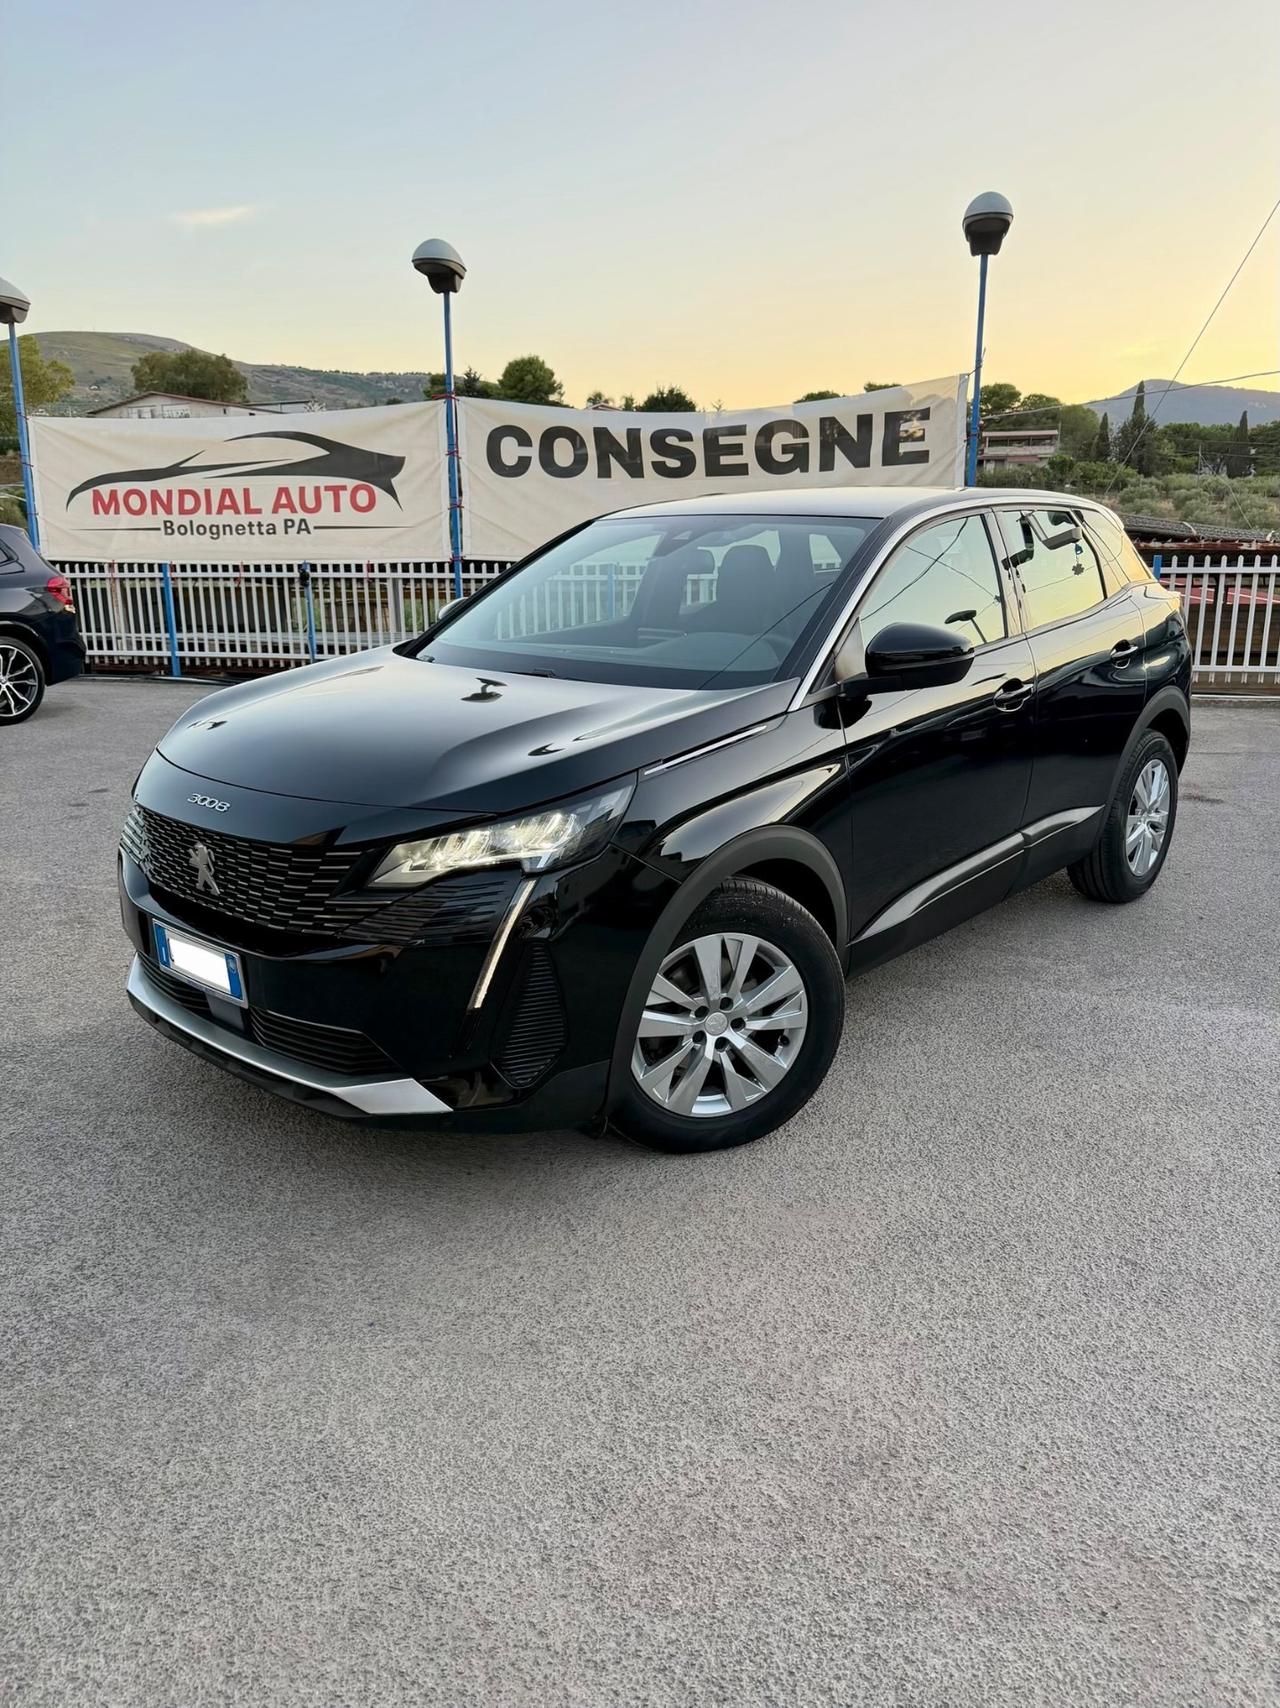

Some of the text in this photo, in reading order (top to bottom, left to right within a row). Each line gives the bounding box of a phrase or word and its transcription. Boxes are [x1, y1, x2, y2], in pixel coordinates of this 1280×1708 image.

[486, 408, 930, 479] CONSEGNE
[92, 484, 376, 516] MONDIAL AUTO
[163, 518, 311, 540] Bolognetta PA
[187, 793, 230, 812] 3008
